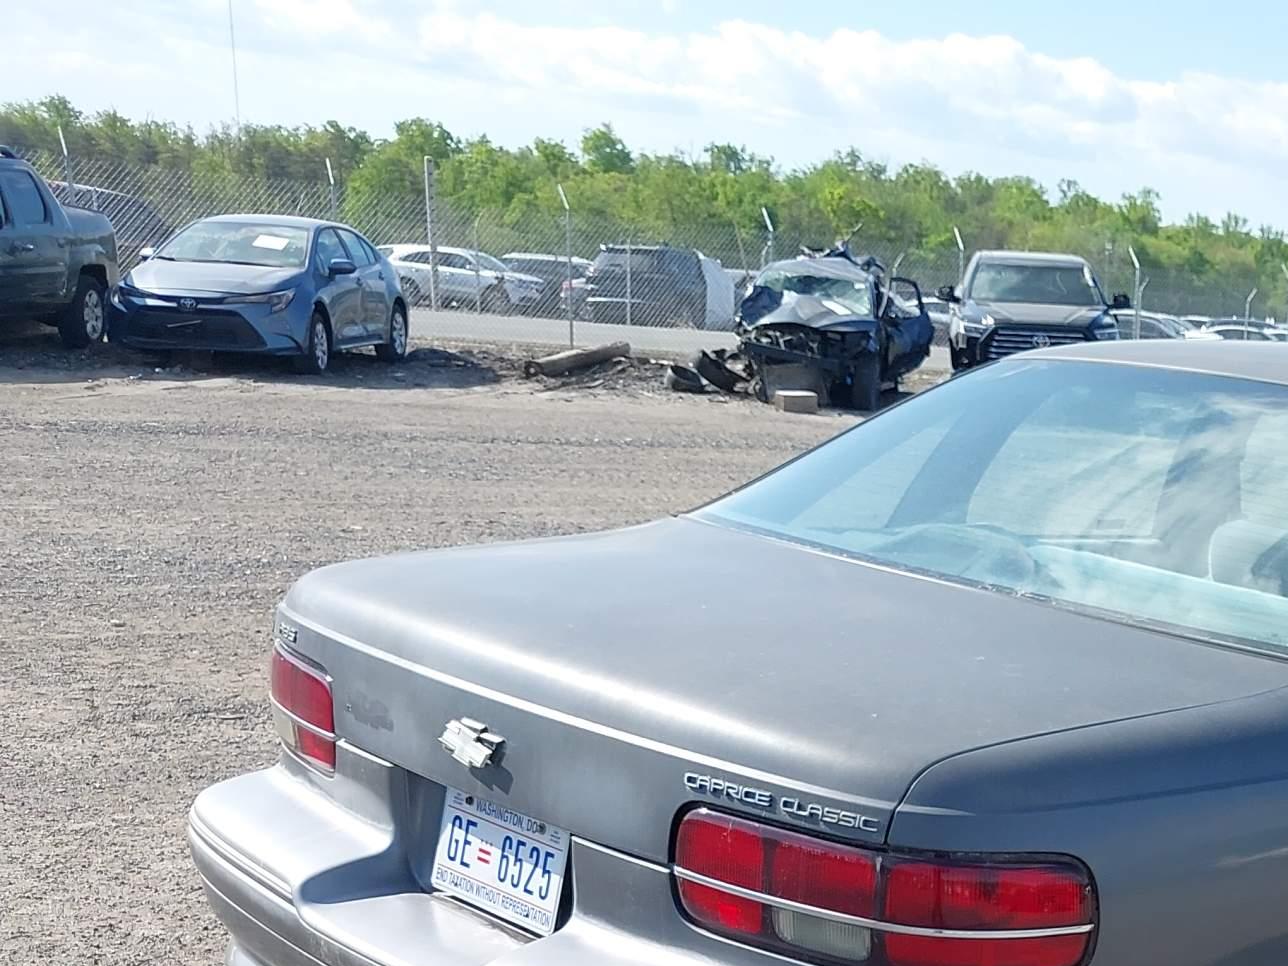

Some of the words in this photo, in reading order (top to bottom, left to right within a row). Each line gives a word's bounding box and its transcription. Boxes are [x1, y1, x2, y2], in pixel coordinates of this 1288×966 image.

[683, 771, 772, 807] CAPRICE
[779, 796, 880, 832] CLASSIC
[435, 867, 449, 882] END
[475, 886, 502, 905] WITHOUT
[446, 814, 478, 869] GE
[497, 835, 556, 901] 6525
